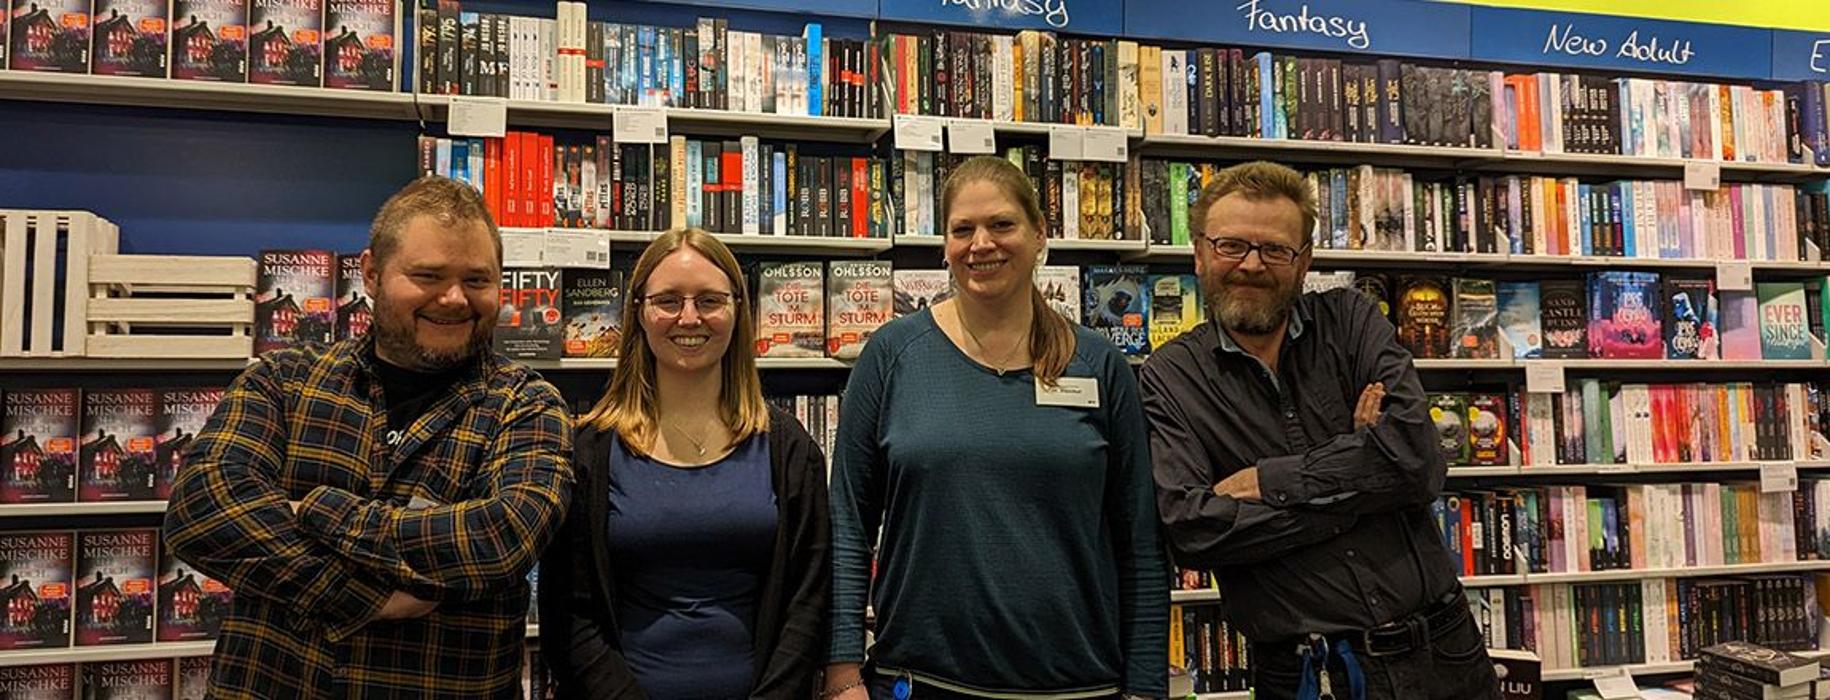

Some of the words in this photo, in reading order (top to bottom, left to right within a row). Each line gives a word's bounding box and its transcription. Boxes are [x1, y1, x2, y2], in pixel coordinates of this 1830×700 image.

[329, 3, 391, 15] MISCHKE
[941, 0, 1069, 27] nasy
[1236, 0, 1370, 49] Fantasy
[1543, 23, 1607, 56] New
[1616, 30, 1696, 65] Adult
[264, 254, 329, 265] SUSANNE
[264, 265, 329, 277] MISCHKE
[763, 267, 821, 278] OHLSSON
[833, 266, 891, 277] OHLSSON
[501, 271, 559, 290] FIFTY
[498, 289, 559, 308] FIFTY
[565, 287, 618, 298] SANDBERG
[776, 291, 809, 303] TOTE
[845, 290, 879, 302] TOTE
[769, 313, 817, 325] STURM
[839, 312, 886, 324] STURM
[1764, 304, 1802, 322] EVER
[1766, 323, 1804, 340] SINCE
[6, 392, 73, 404] SUSANNE
[87, 393, 152, 404] SUSANNE
[163, 391, 224, 402] SUSANN
[6, 405, 73, 417] MISCHKE
[87, 405, 153, 416] MISCHKE
[163, 403, 216, 415] MISCH
[1, 536, 68, 549] SUSANNE
[84, 534, 150, 546] SUSANNE
[0, 549, 68, 561] MISCHKE
[84, 546, 151, 558] MISCHKE
[1, 666, 69, 679] SUSANNE
[102, 662, 168, 675] SUSANNE
[0, 679, 70, 692] MISCHKE
[101, 675, 168, 688] MISCHKE
[1508, 683, 1532, 694] LIU
